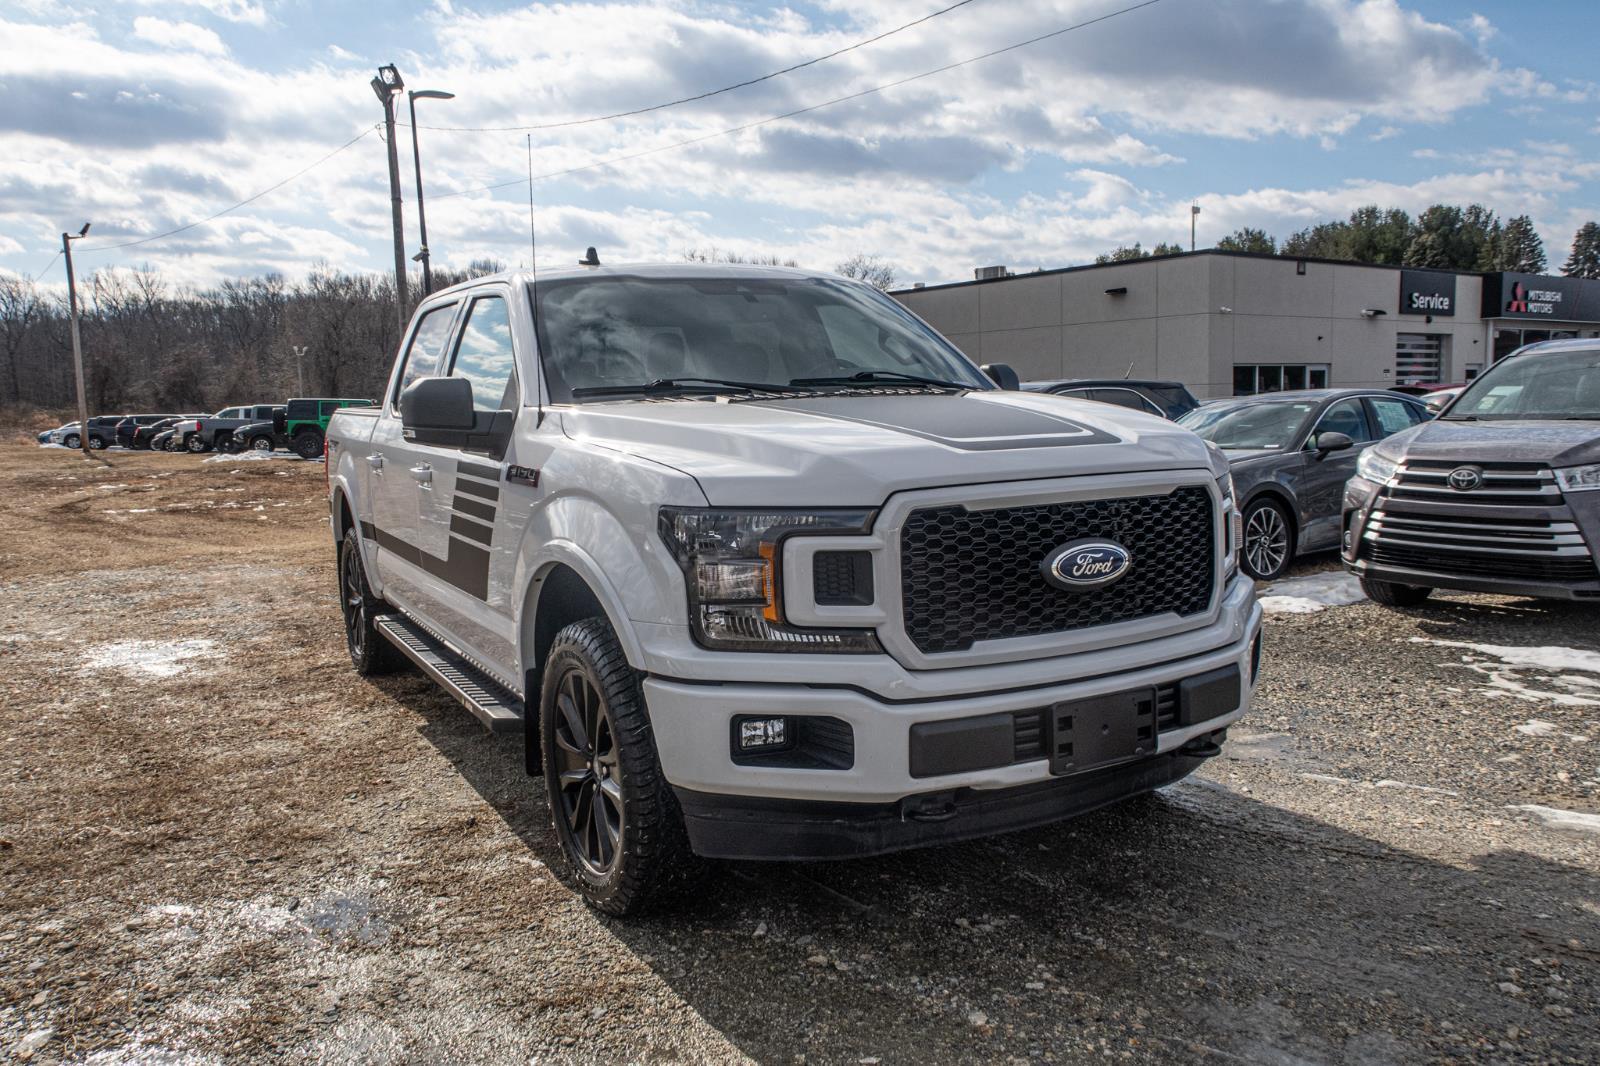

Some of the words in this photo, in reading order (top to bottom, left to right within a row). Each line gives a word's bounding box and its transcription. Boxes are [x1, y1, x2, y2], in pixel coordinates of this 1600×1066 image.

[1412, 292, 1449, 310] Service
[1528, 290, 1561, 302] MITSUBISHI
[1528, 303, 1552, 314] MOTORS
[1073, 552, 1113, 576] Ford
